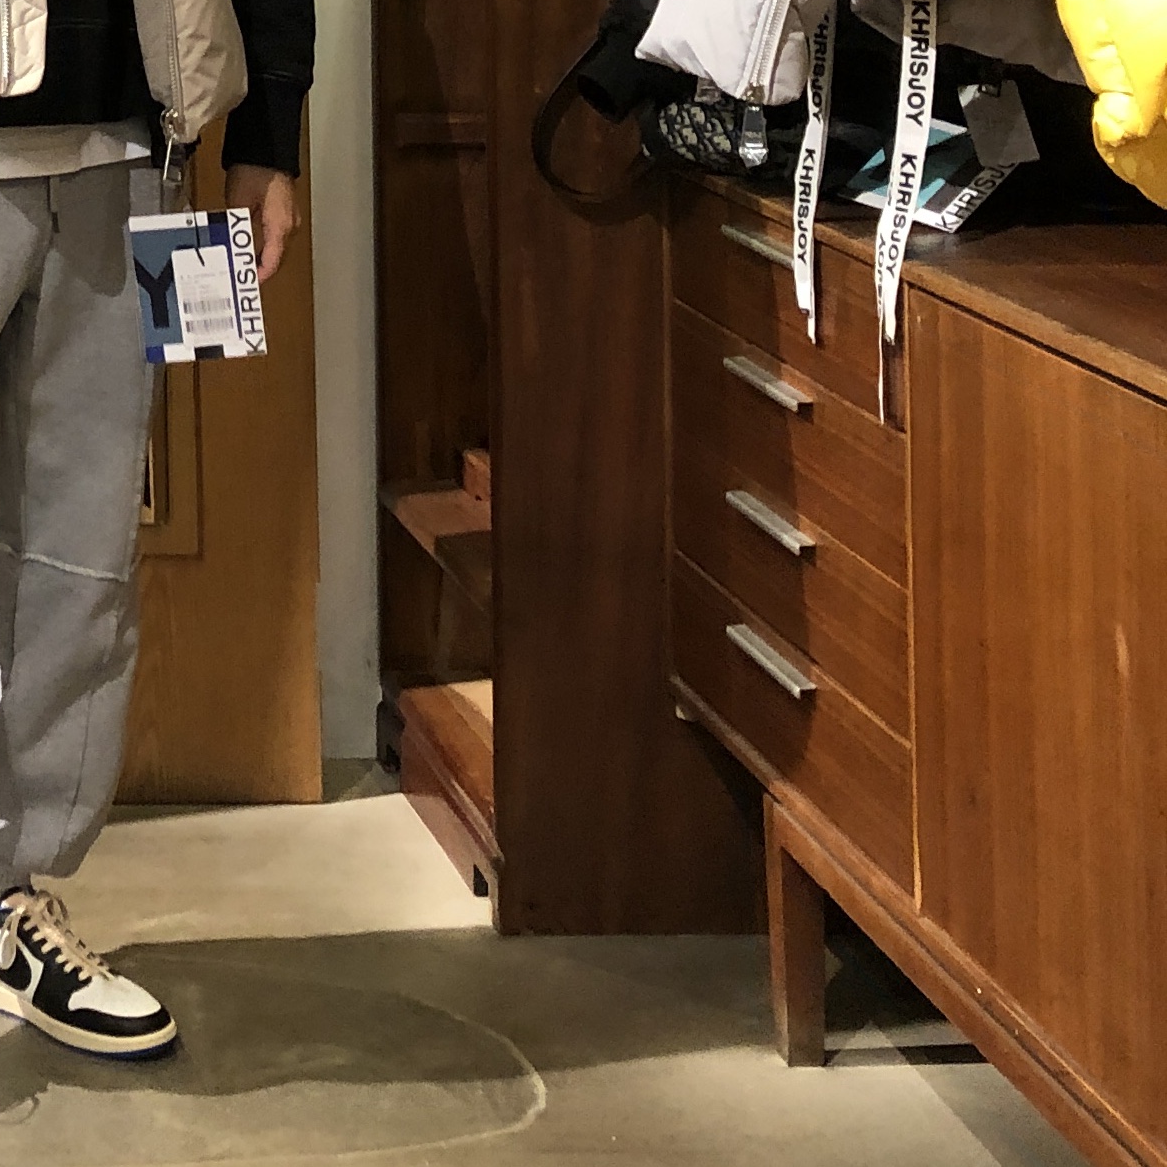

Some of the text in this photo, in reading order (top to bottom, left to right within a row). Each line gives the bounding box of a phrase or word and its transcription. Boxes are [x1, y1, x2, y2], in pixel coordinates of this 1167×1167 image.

[903, 0, 932, 128] KHRISJOY
[796, 148, 817, 266] KHRISJOY
[885, 153, 918, 280] KHRISJOY
[934, 162, 1017, 231] KHRISJ
[229, 211, 266, 355] KHRISJOY
